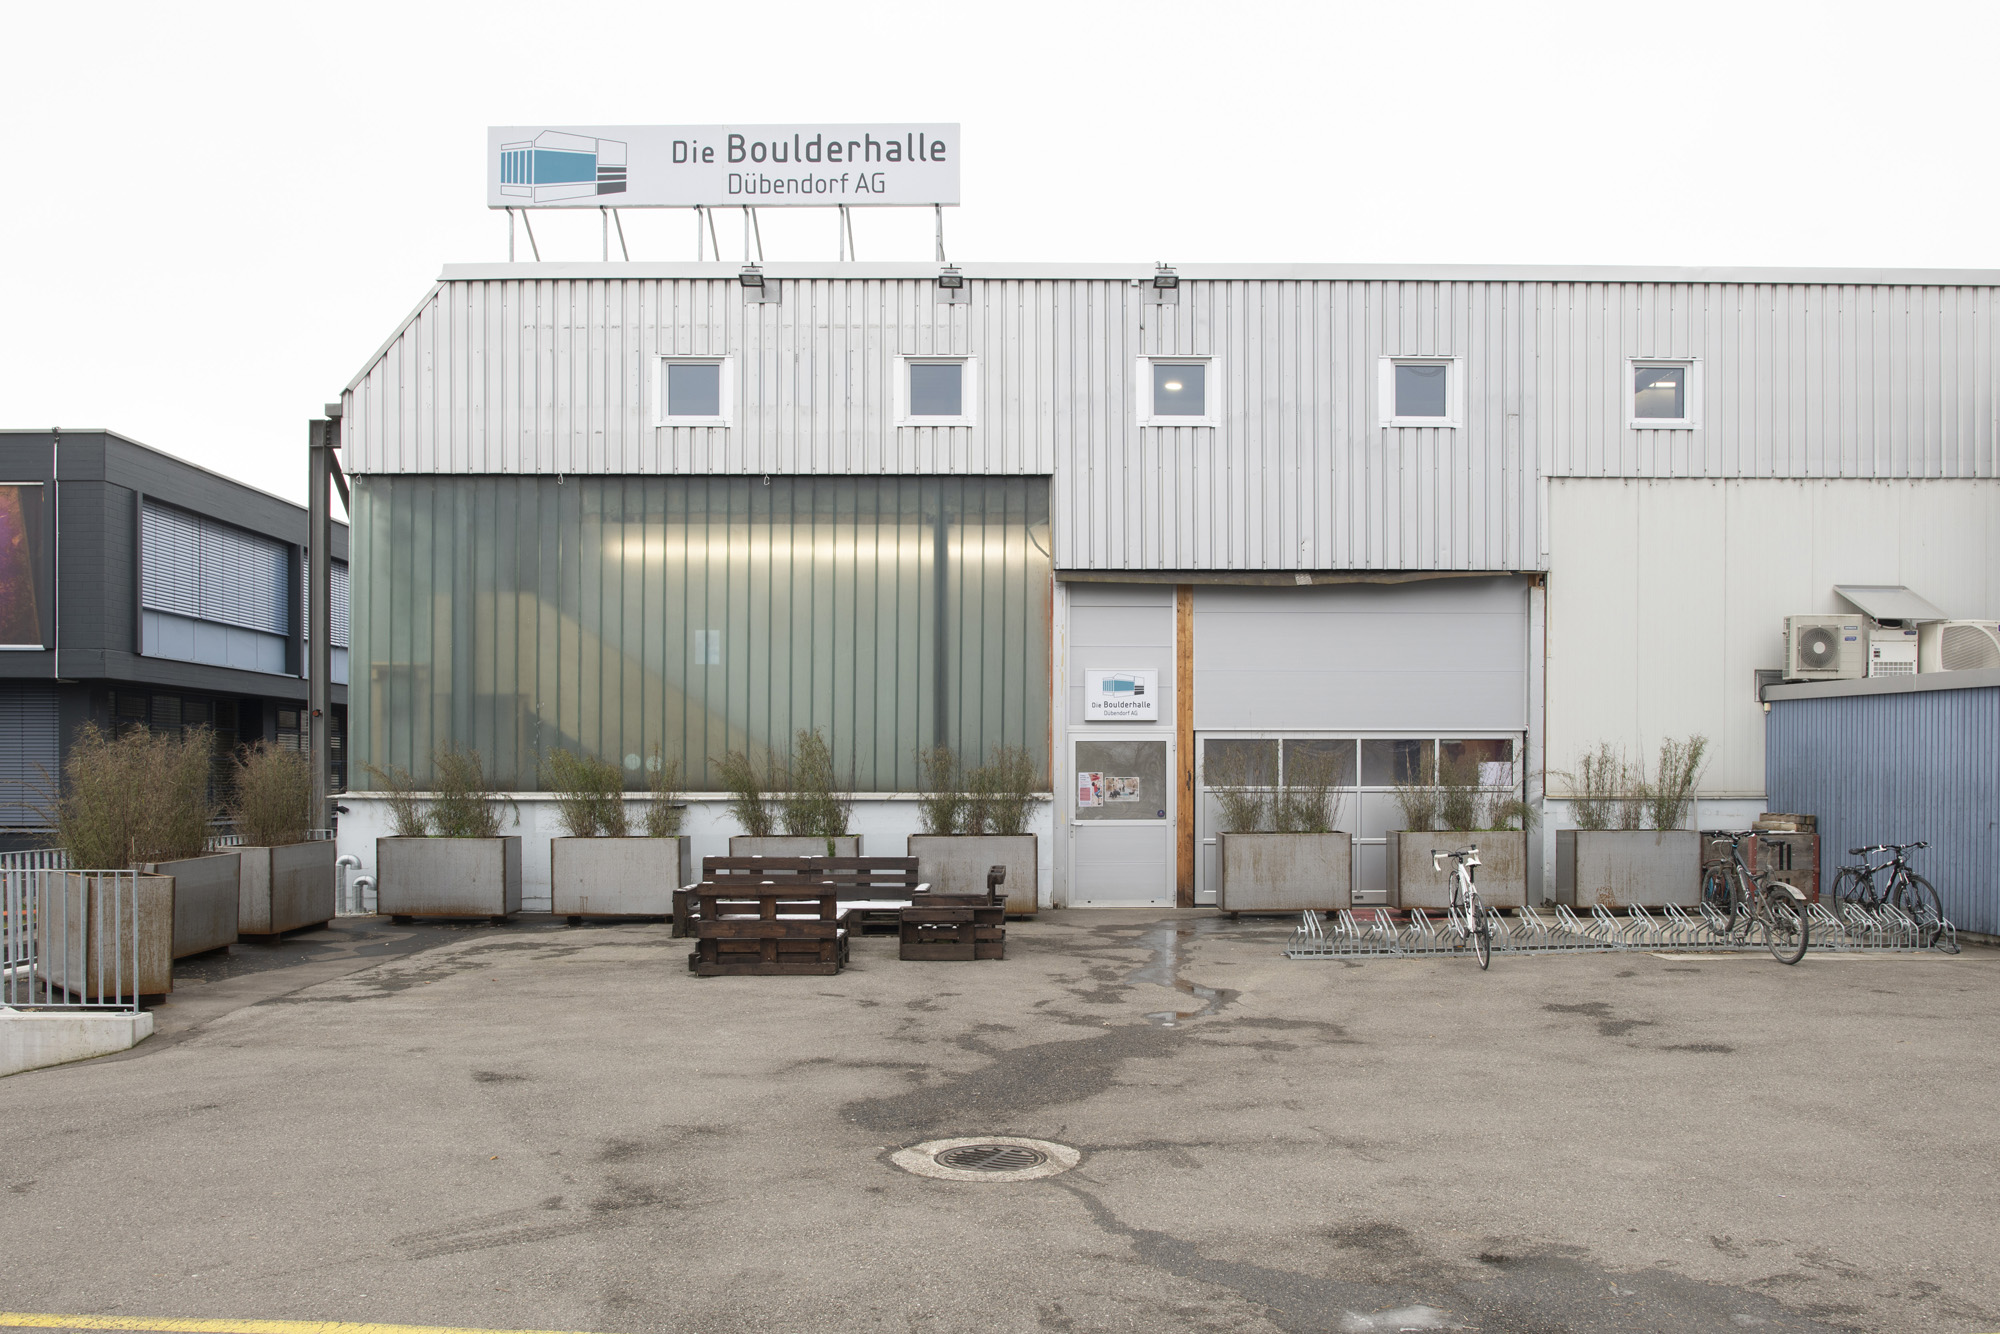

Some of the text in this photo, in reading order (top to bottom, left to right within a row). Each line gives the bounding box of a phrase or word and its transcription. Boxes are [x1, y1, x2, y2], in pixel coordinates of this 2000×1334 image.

[672, 132, 947, 164] Die Boulderhalle
[728, 172, 886, 195] Dübendorf AG
